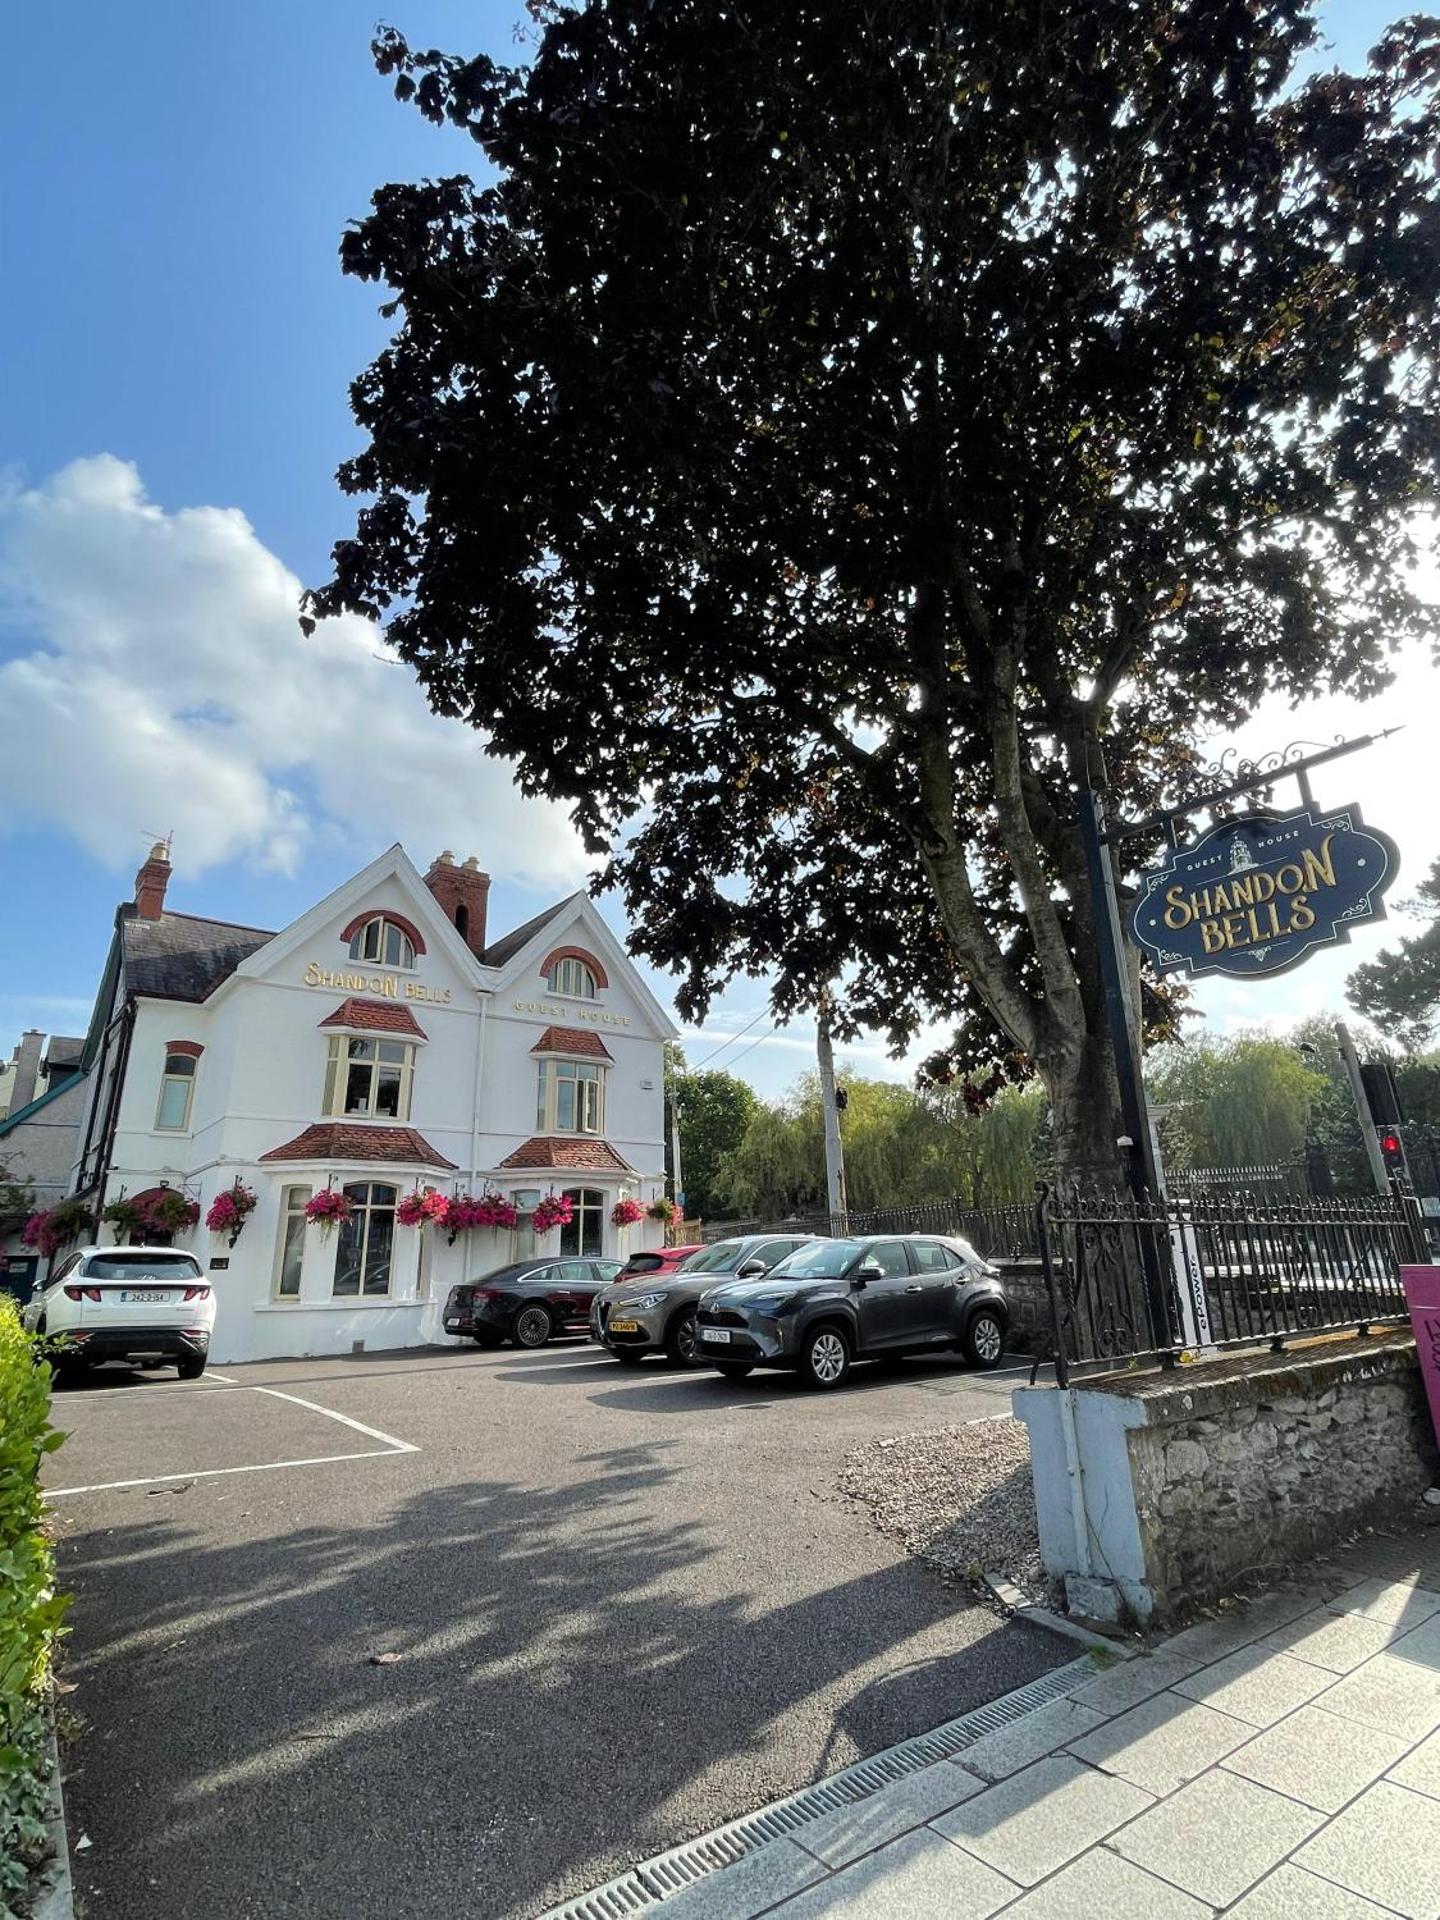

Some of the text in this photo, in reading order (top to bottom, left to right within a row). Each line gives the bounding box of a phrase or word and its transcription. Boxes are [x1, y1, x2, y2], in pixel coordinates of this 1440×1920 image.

[1187, 829, 1300, 872] GUEST HOUSE
[1163, 833, 1337, 930] SHANDON
[1200, 895, 1316, 954] BELLS
[304, 961, 452, 1004] SHANDON BELLS
[514, 1001, 632, 1026] GUEST HOUSE
